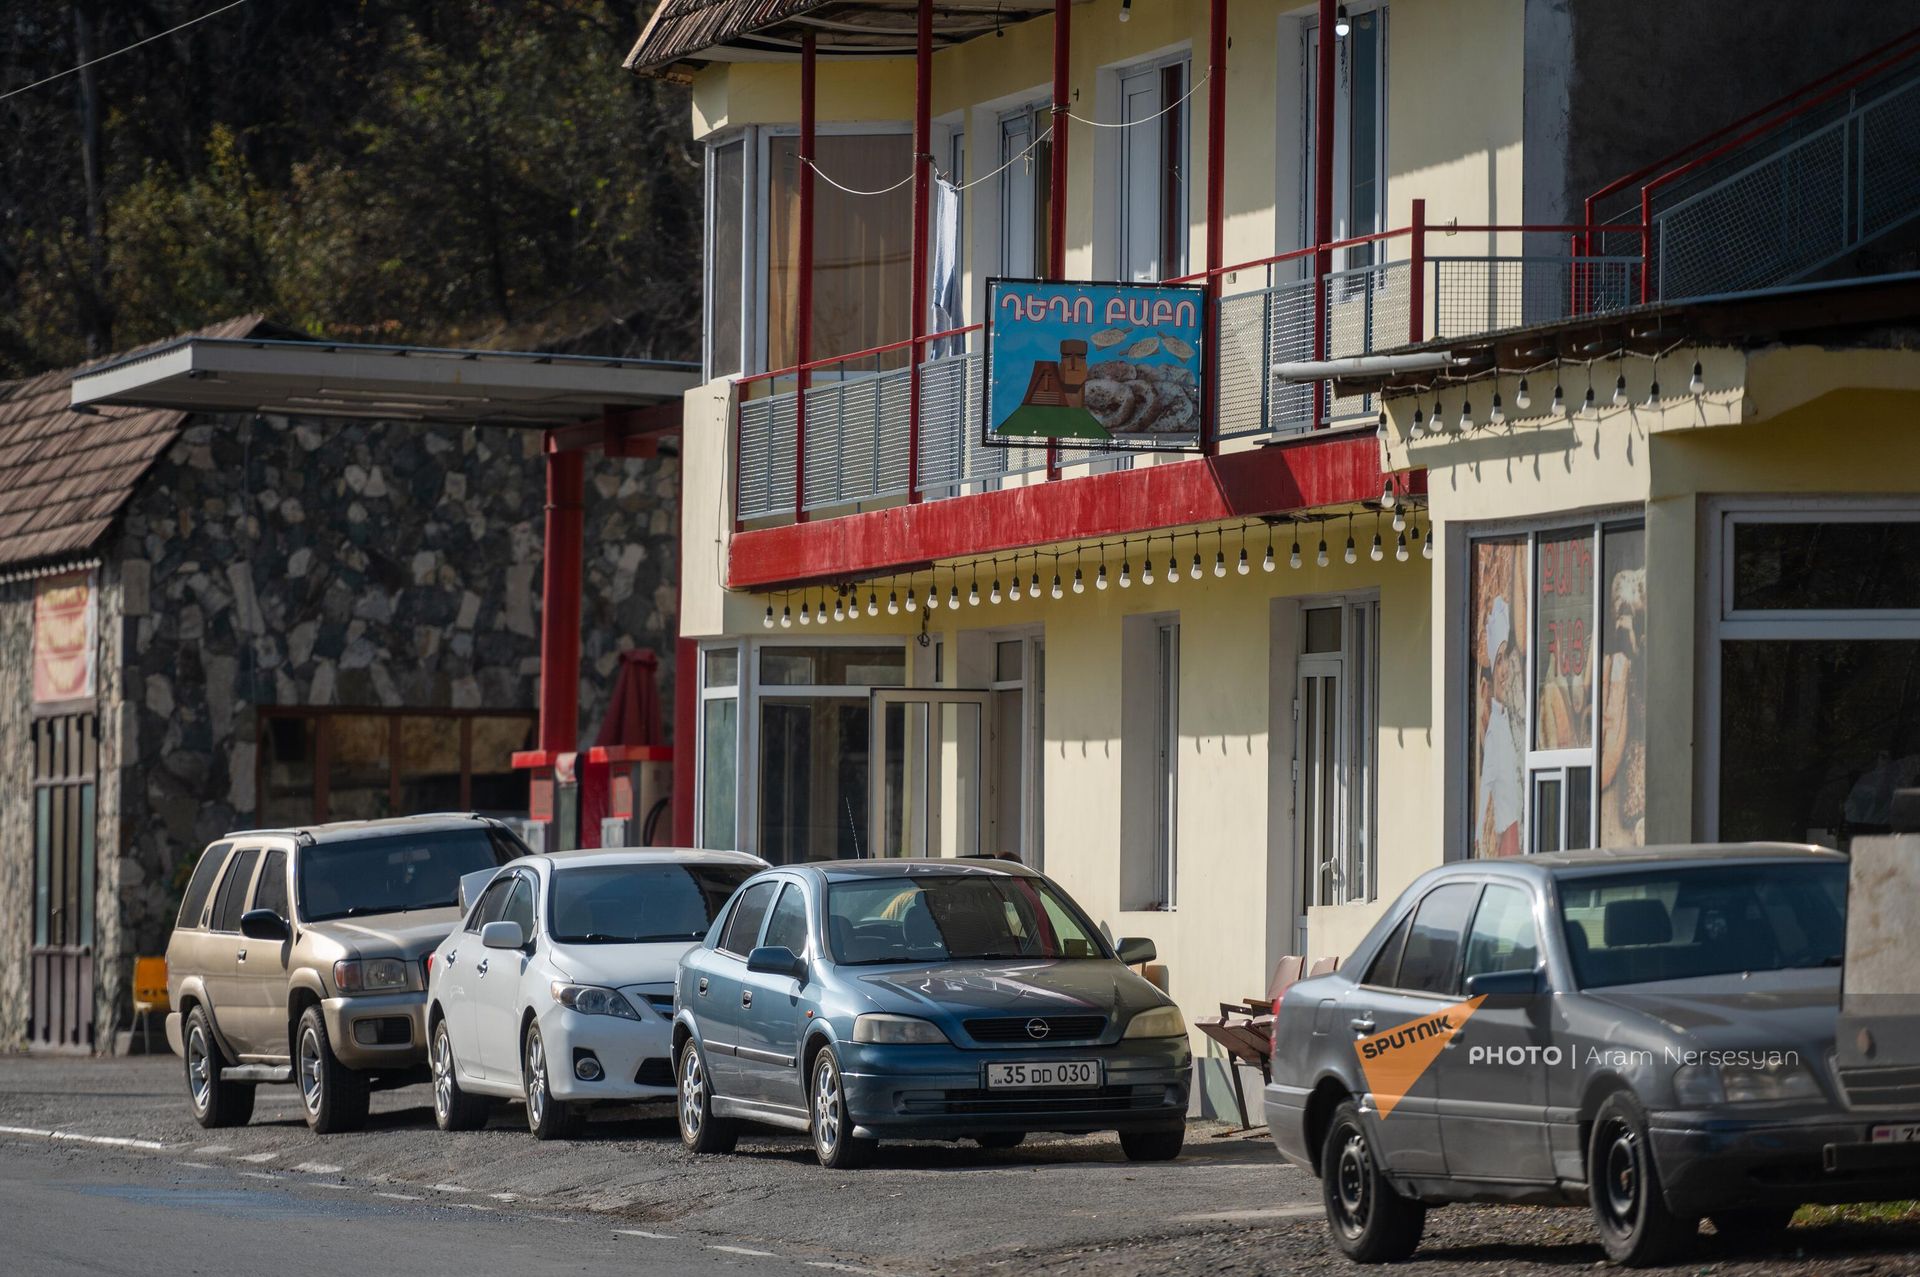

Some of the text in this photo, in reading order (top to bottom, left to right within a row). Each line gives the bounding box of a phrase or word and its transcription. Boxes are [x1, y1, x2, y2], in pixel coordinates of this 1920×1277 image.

[1001, 293, 1196, 328] ԴԵԴՈ ԲԱԲՈ
[1003, 1066, 1026, 1084] 35
[1031, 1069, 1052, 1083] DD
[1057, 1064, 1090, 1082] 030
